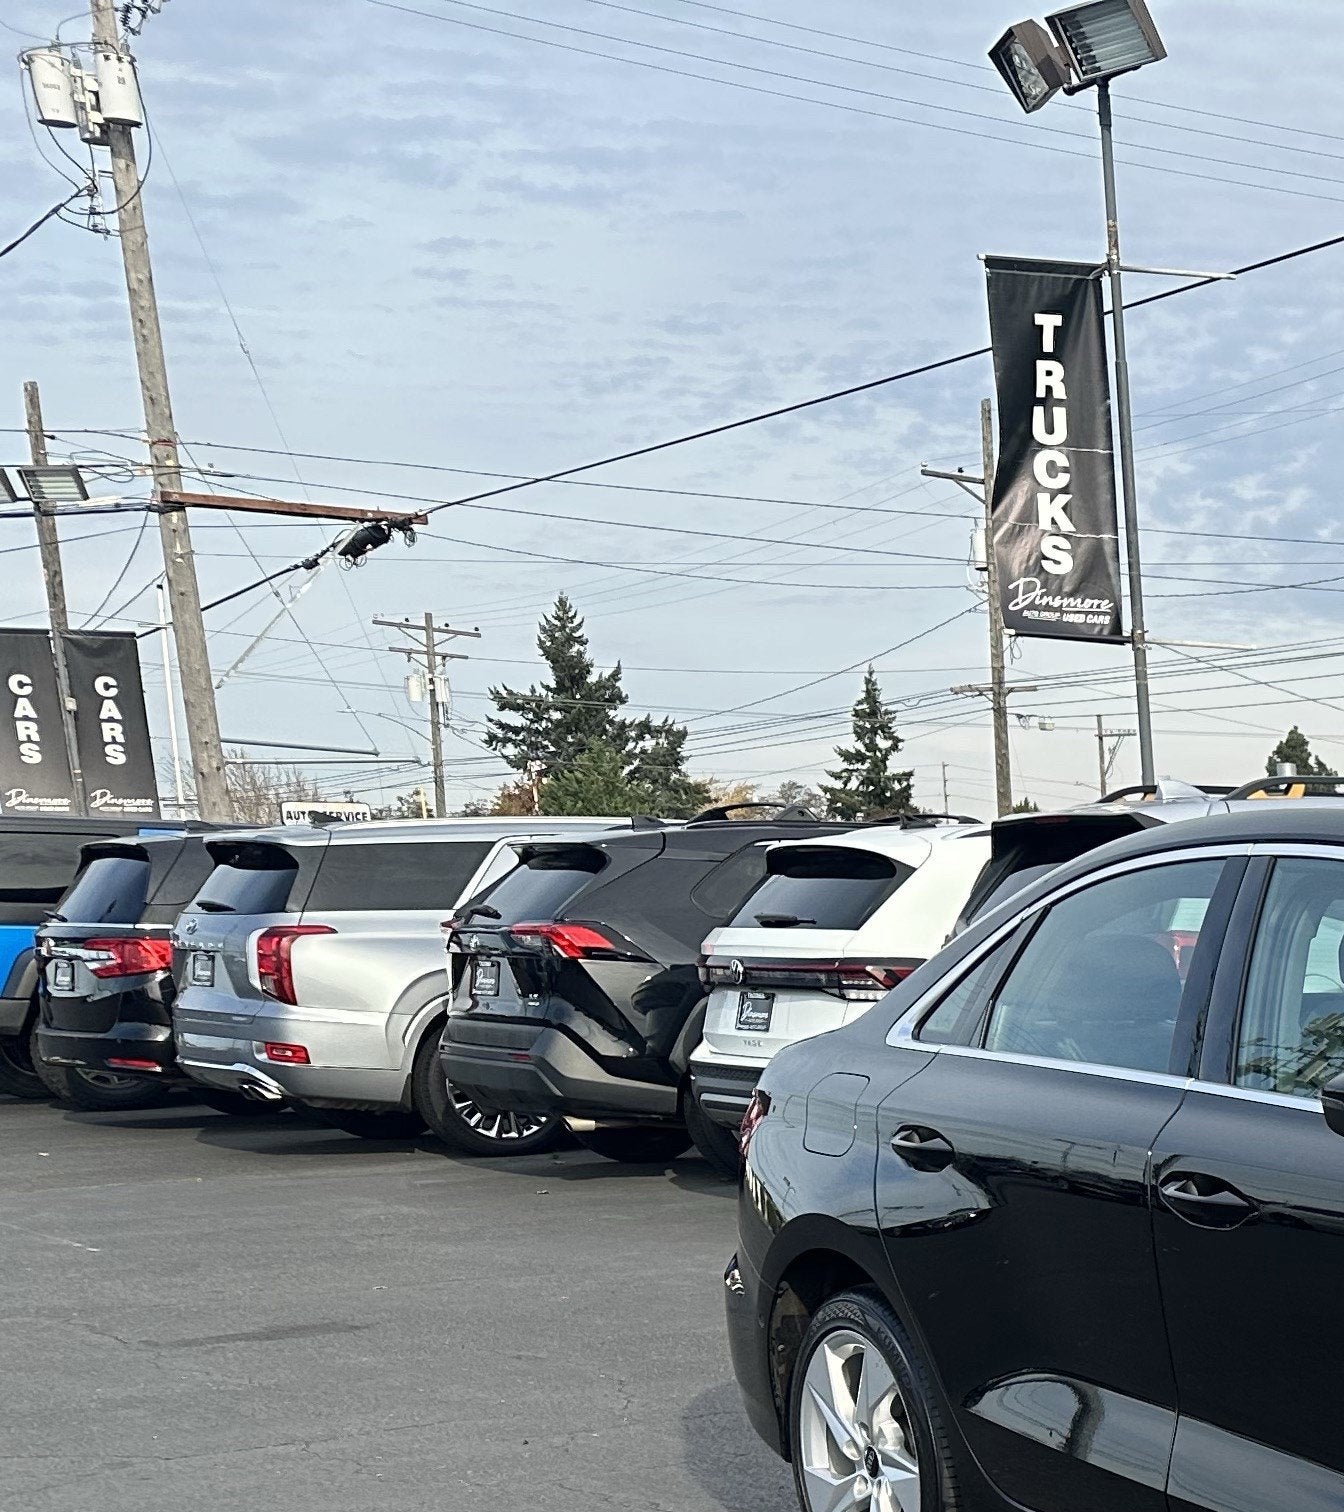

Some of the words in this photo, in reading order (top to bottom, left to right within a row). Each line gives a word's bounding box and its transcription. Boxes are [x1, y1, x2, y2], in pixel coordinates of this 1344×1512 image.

[1032, 313, 1073, 575] TRUCKS
[1008, 577, 1114, 611] Dinsmore
[1087, 614, 1111, 625] CARS
[8, 674, 42, 764] CARS
[94, 676, 126, 765] CARS
